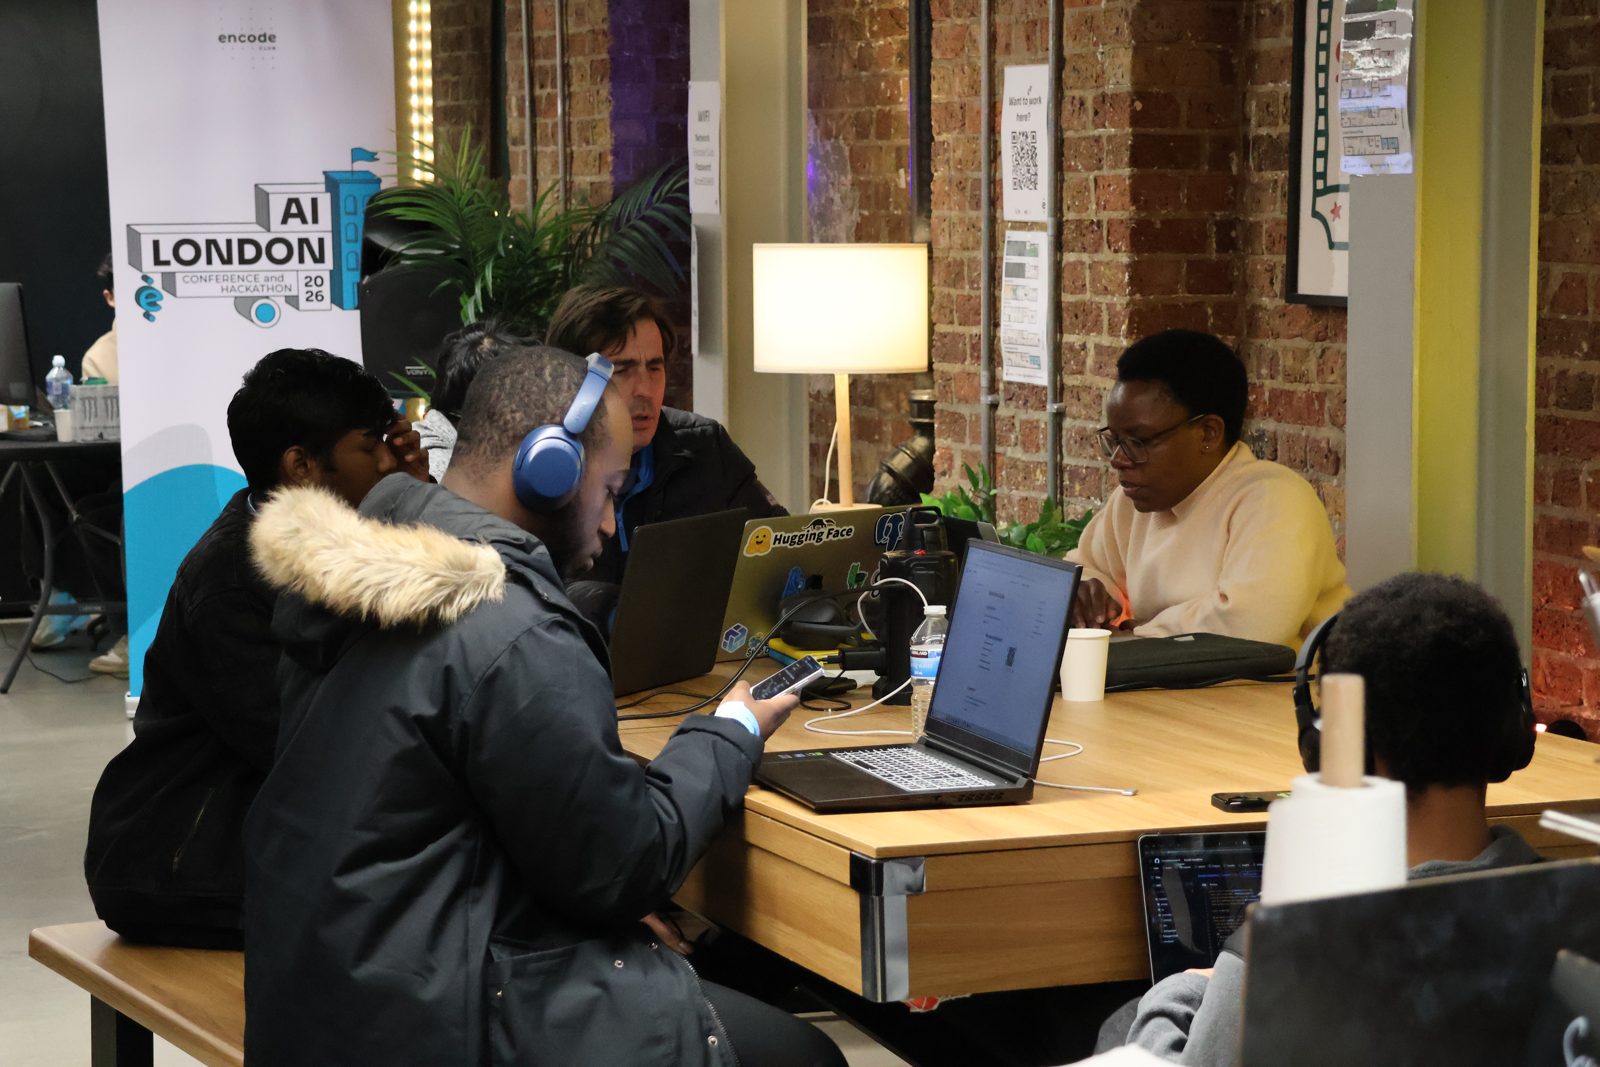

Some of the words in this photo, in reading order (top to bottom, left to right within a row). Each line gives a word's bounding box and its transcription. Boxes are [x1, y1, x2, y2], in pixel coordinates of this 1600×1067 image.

[218, 32, 276, 43] encode
[1023, 97, 1028, 105] to
[1029, 96, 1042, 105] work
[1016, 112, 1031, 122] here?
[280, 197, 318, 225] AI
[152, 237, 325, 266] LONDON
[183, 273, 260, 284] CONFERENCE
[263, 273, 284, 283] and
[304, 275, 324, 287] 20
[221, 284, 292, 294] HACKATHON
[305, 290, 324, 302] 26
[773, 529, 825, 546] Hugging
[826, 527, 853, 539] Face
